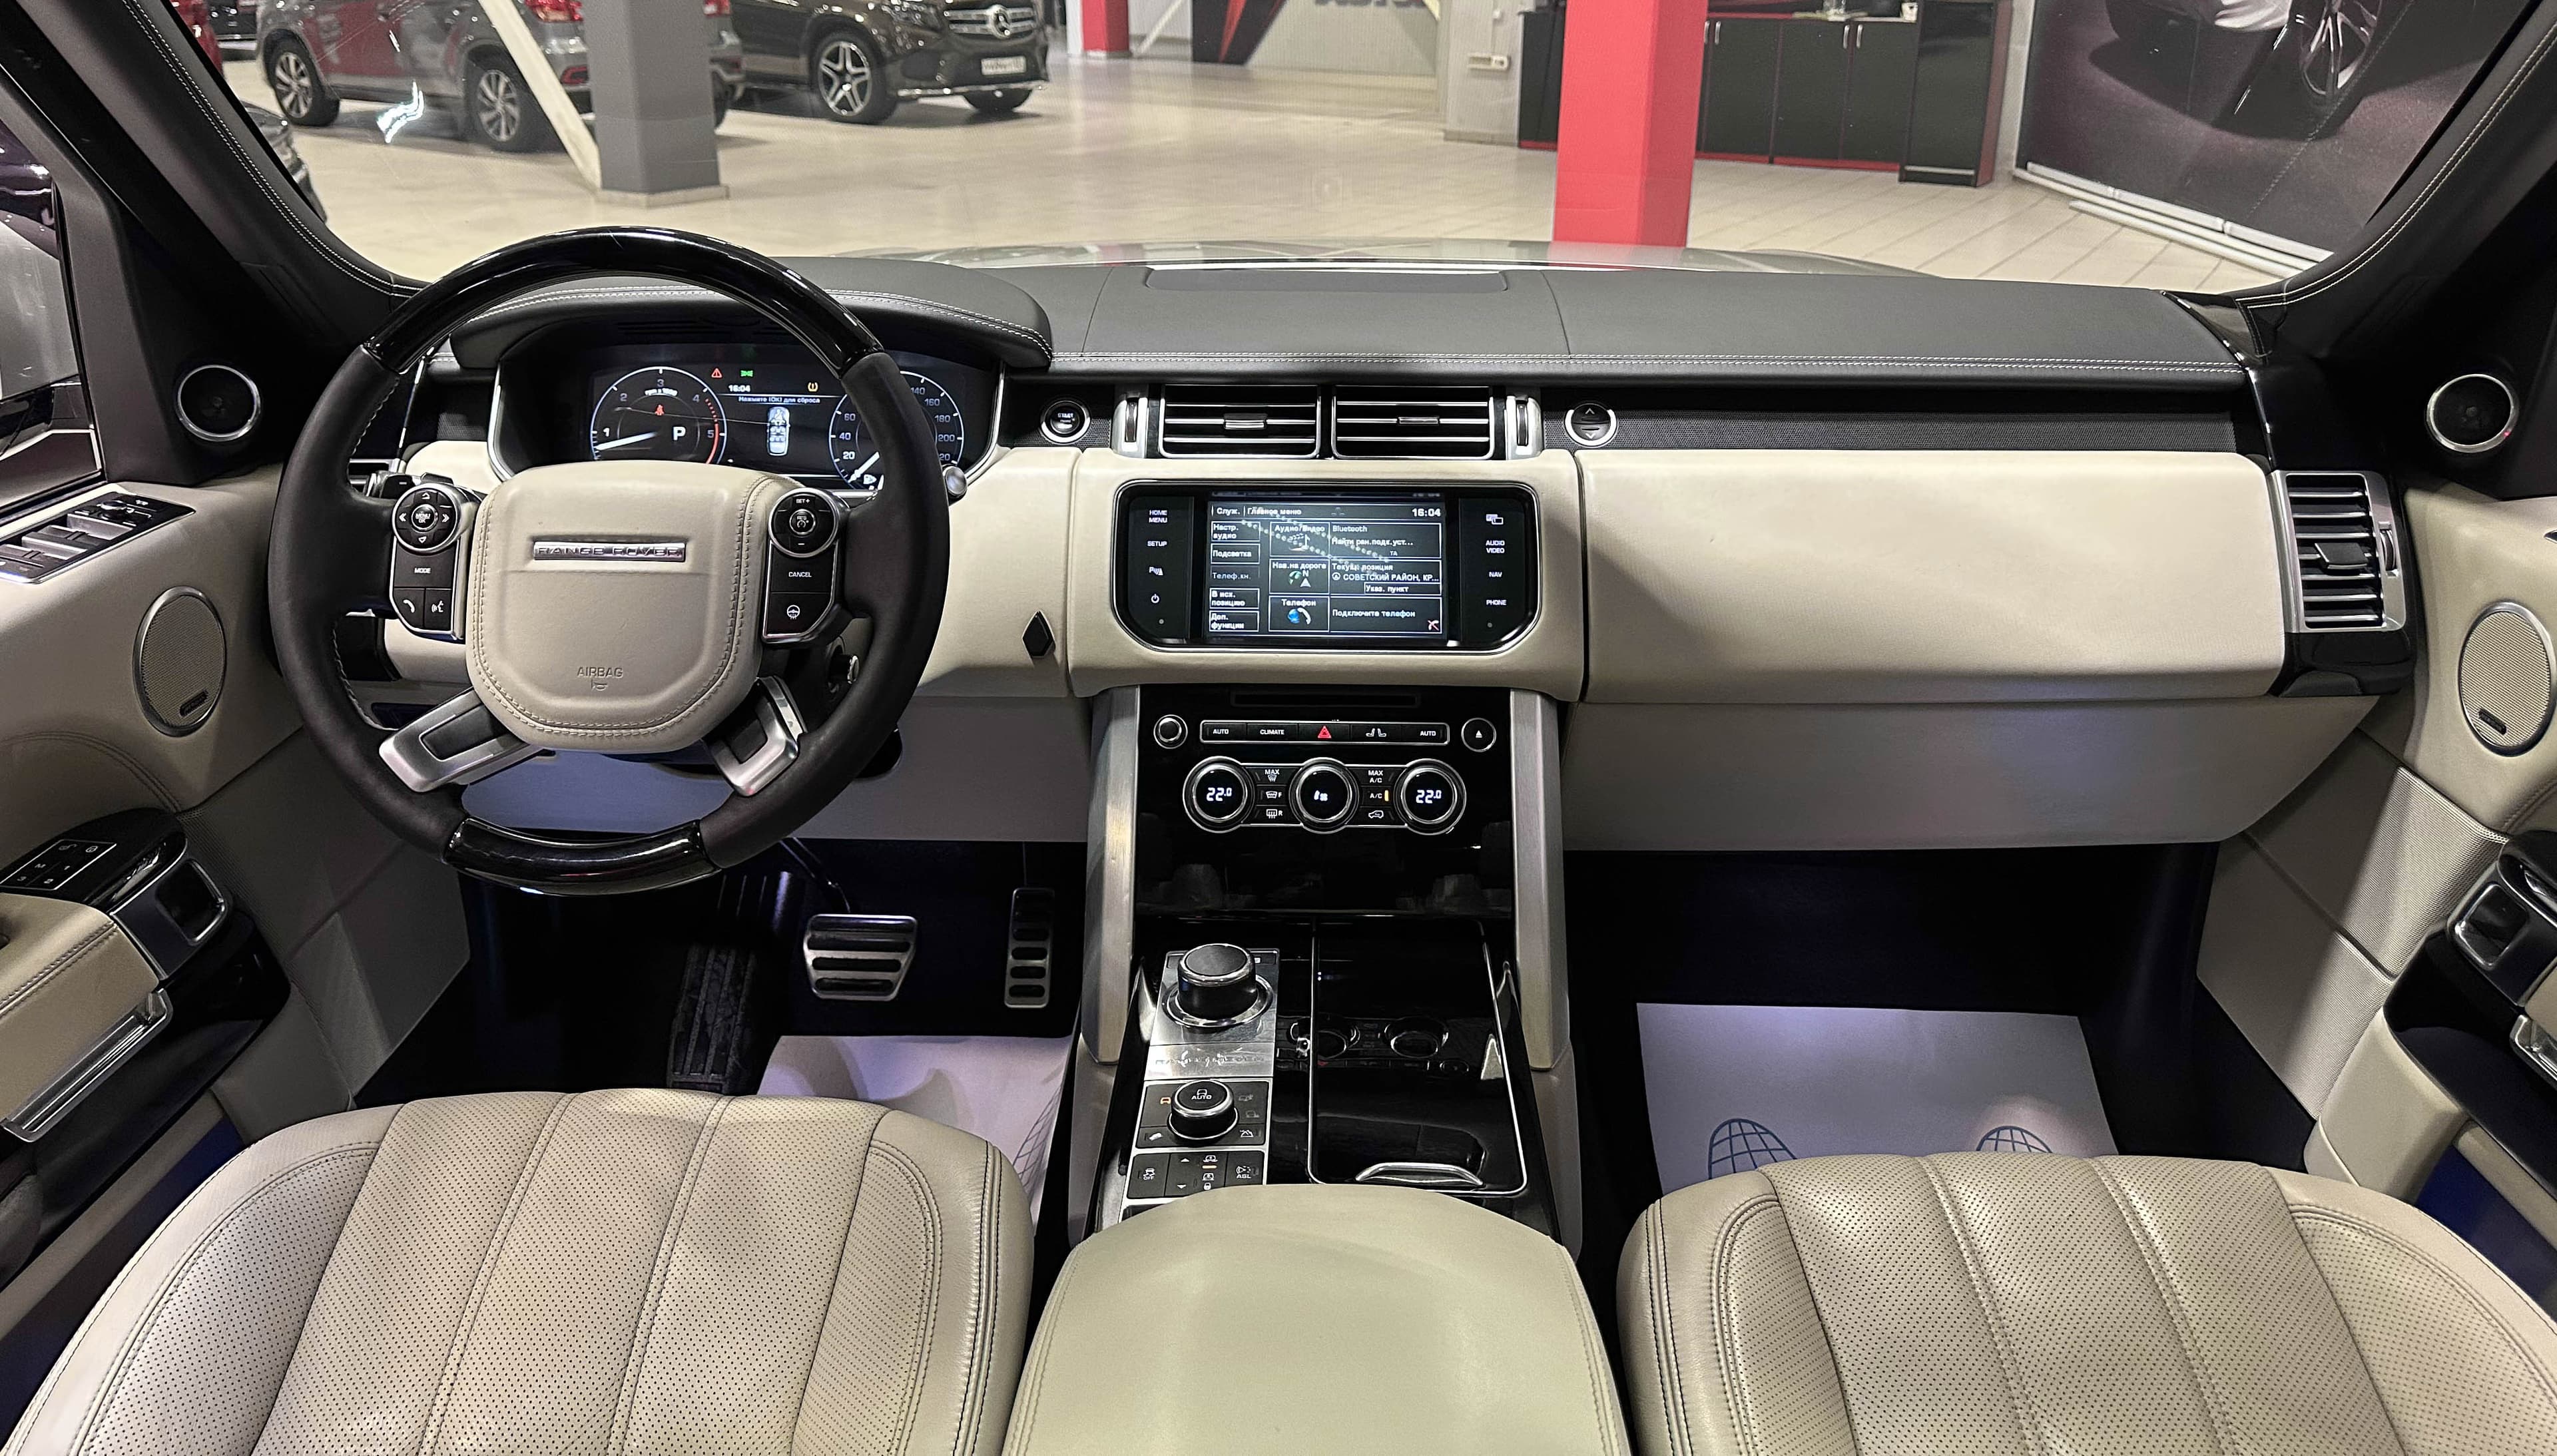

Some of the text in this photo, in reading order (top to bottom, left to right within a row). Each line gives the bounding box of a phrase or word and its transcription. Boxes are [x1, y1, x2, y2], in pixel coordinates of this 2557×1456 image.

[620, 393, 627, 401] 2
[693, 394, 700, 403] 4
[603, 427, 610, 437] 1
[673, 426, 686, 441] P
[707, 429, 714, 438] 5
[1217, 507, 1240, 516] Служ.
[1412, 508, 1441, 517] 16:04
[537, 546, 681, 557] RANGE ROVER
[1343, 573, 1390, 581] СОВЕТСКИЙ
[1392, 573, 1420, 582] РАЙОН,
[577, 666, 623, 678] AIRBAG
[1207, 788, 1232, 802] 22.0
[1416, 790, 1442, 804] 22.0
